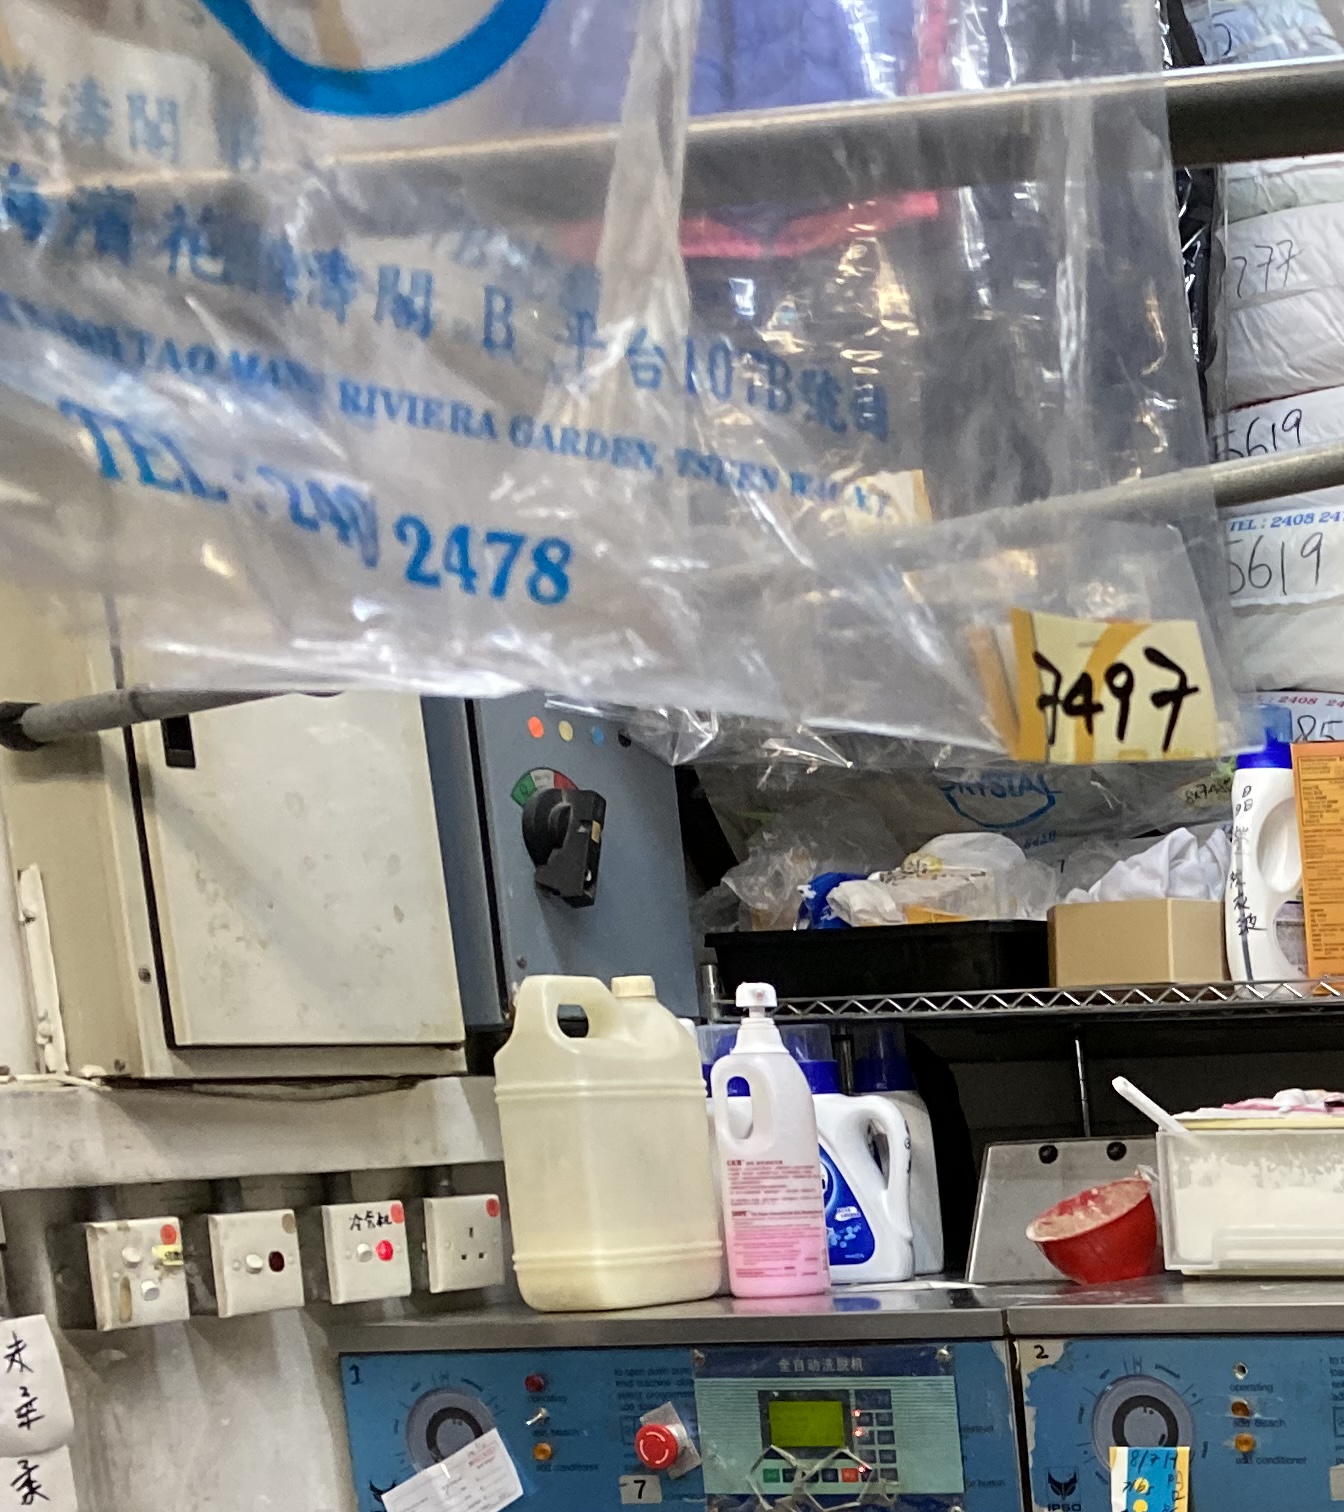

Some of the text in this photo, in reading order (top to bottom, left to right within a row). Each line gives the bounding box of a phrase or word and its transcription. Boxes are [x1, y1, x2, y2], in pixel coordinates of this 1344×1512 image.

[339, 378, 499, 441] RIVIERA
[1270, 512, 1315, 529] 2408
[393, 514, 573, 603] 2478
[1032, 646, 1199, 752] 7497
[1033, 1344, 1049, 1359] 2
[1256, 1456, 1307, 1465] conditioner
[633, 1479, 647, 1499] 7
